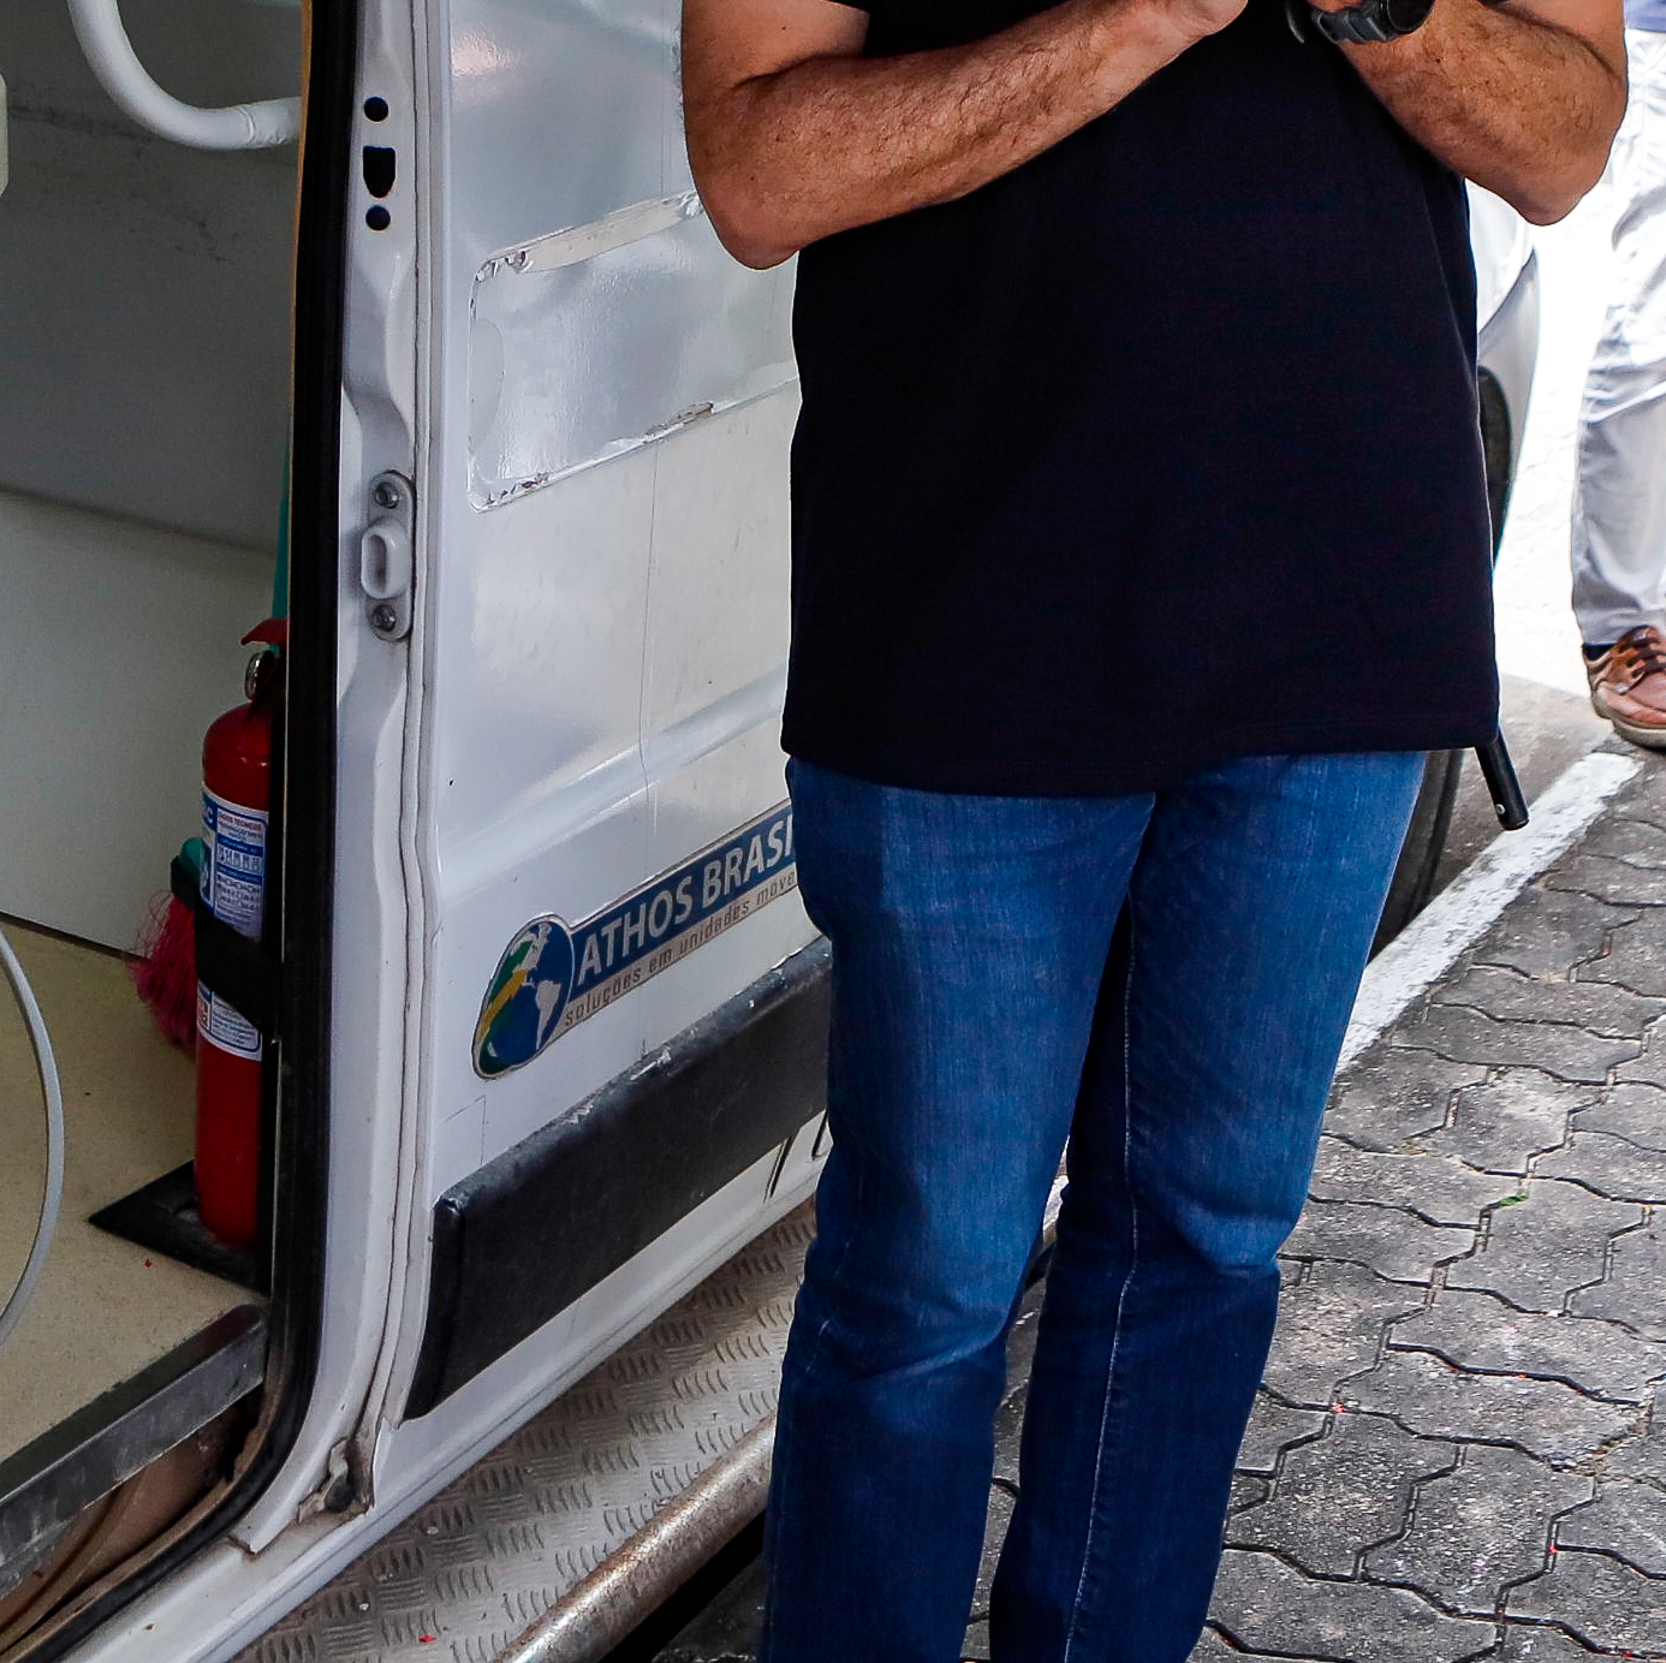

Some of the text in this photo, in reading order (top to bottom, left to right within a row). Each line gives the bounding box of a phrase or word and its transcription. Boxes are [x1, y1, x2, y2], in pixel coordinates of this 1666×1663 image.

[577, 814, 793, 986] ATHOS BRASI
[648, 948, 672, 973] em
[679, 899, 750, 955] unidades
